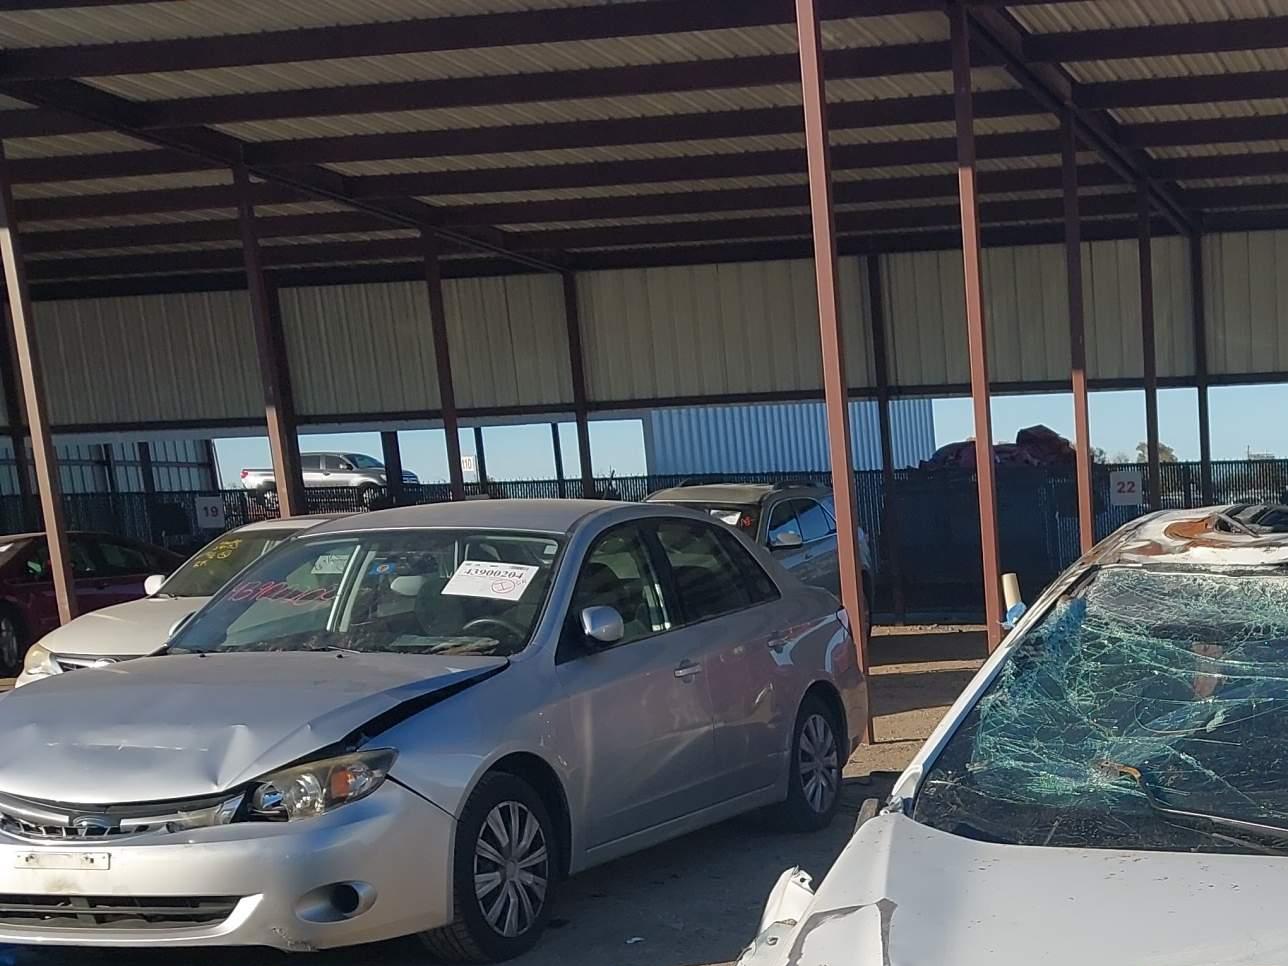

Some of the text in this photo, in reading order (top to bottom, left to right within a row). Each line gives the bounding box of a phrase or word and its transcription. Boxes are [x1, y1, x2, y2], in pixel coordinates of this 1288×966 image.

[1116, 480, 1136, 494] 22
[203, 505, 218, 517] 19
[464, 568, 524, 579] 43900204
